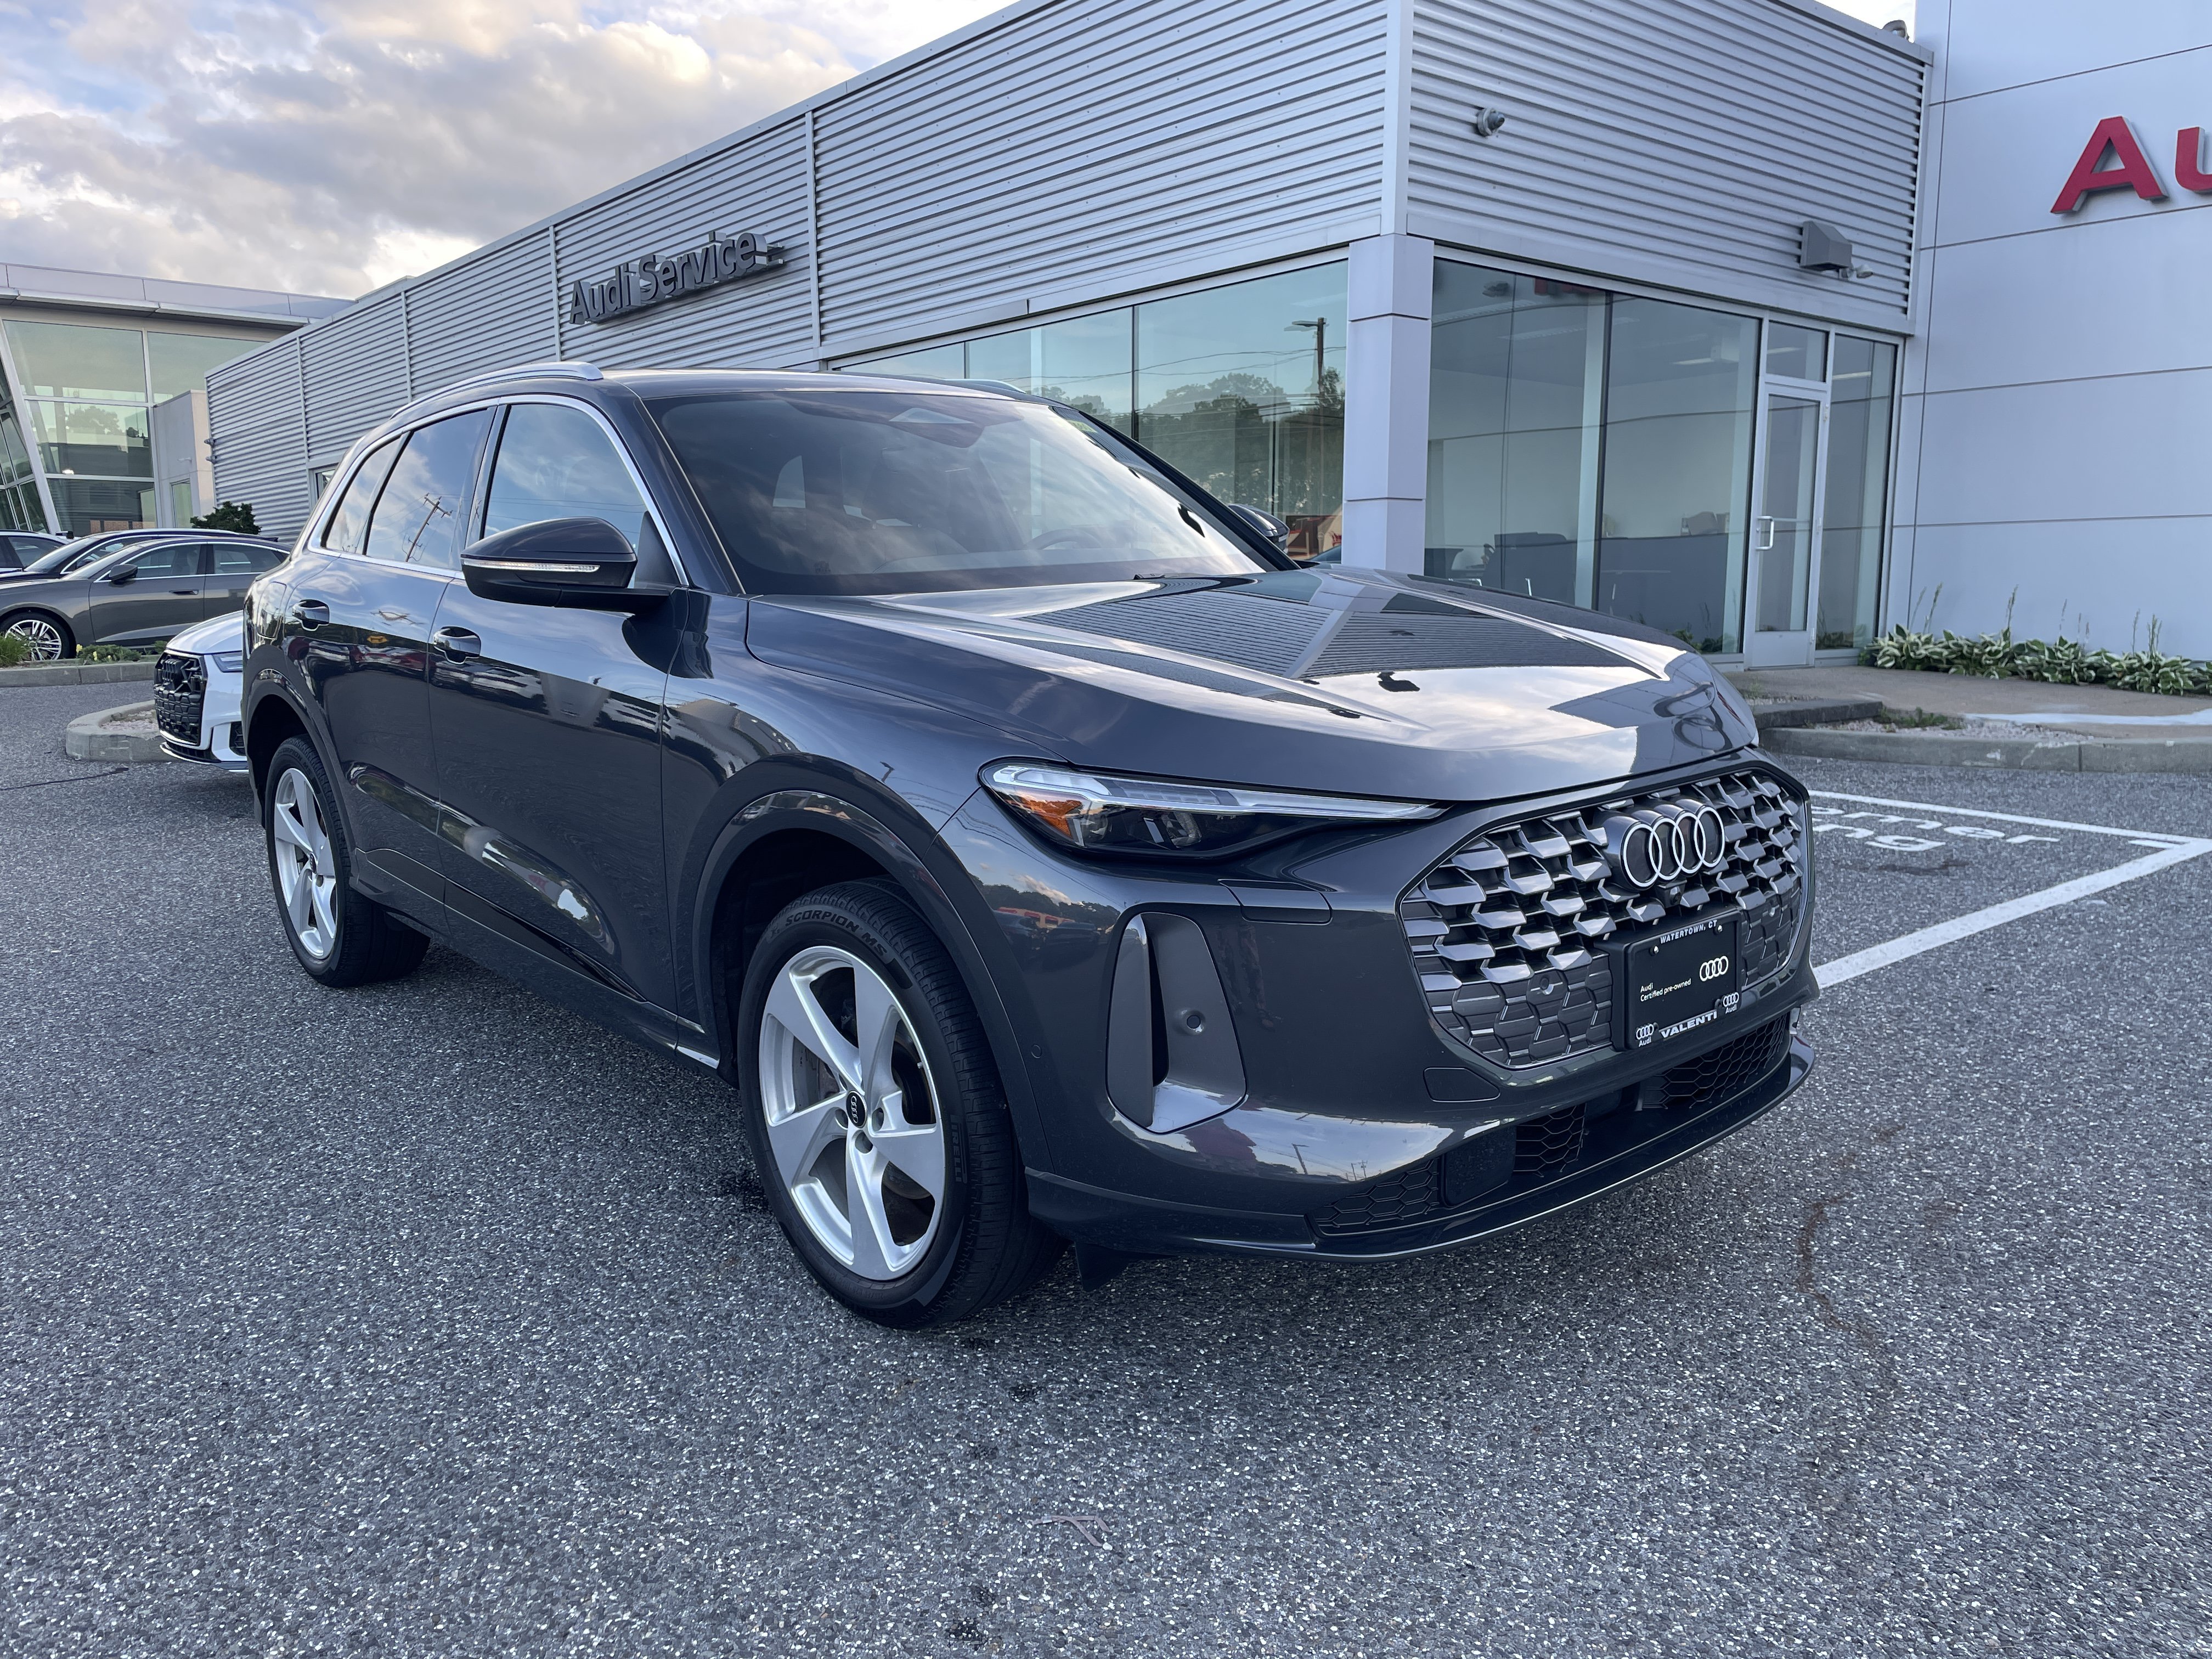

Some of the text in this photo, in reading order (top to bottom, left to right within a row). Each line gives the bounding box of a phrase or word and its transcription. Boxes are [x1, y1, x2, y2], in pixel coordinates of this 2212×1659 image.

[569, 230, 768, 325] Audi Service
[1812, 818, 1946, 852] ng
[785, 910, 888, 957] SCORPION MS
[1660, 919, 1717, 944] WATERTOWN, CT
[1640, 982, 1654, 993] Audi
[1640, 978, 1691, 1002] Certified pre-owned
[1725, 1004, 1737, 1014] Audi
[1661, 1011, 1717, 1039] VALENTI
[1638, 1037, 1652, 1047] Audi
